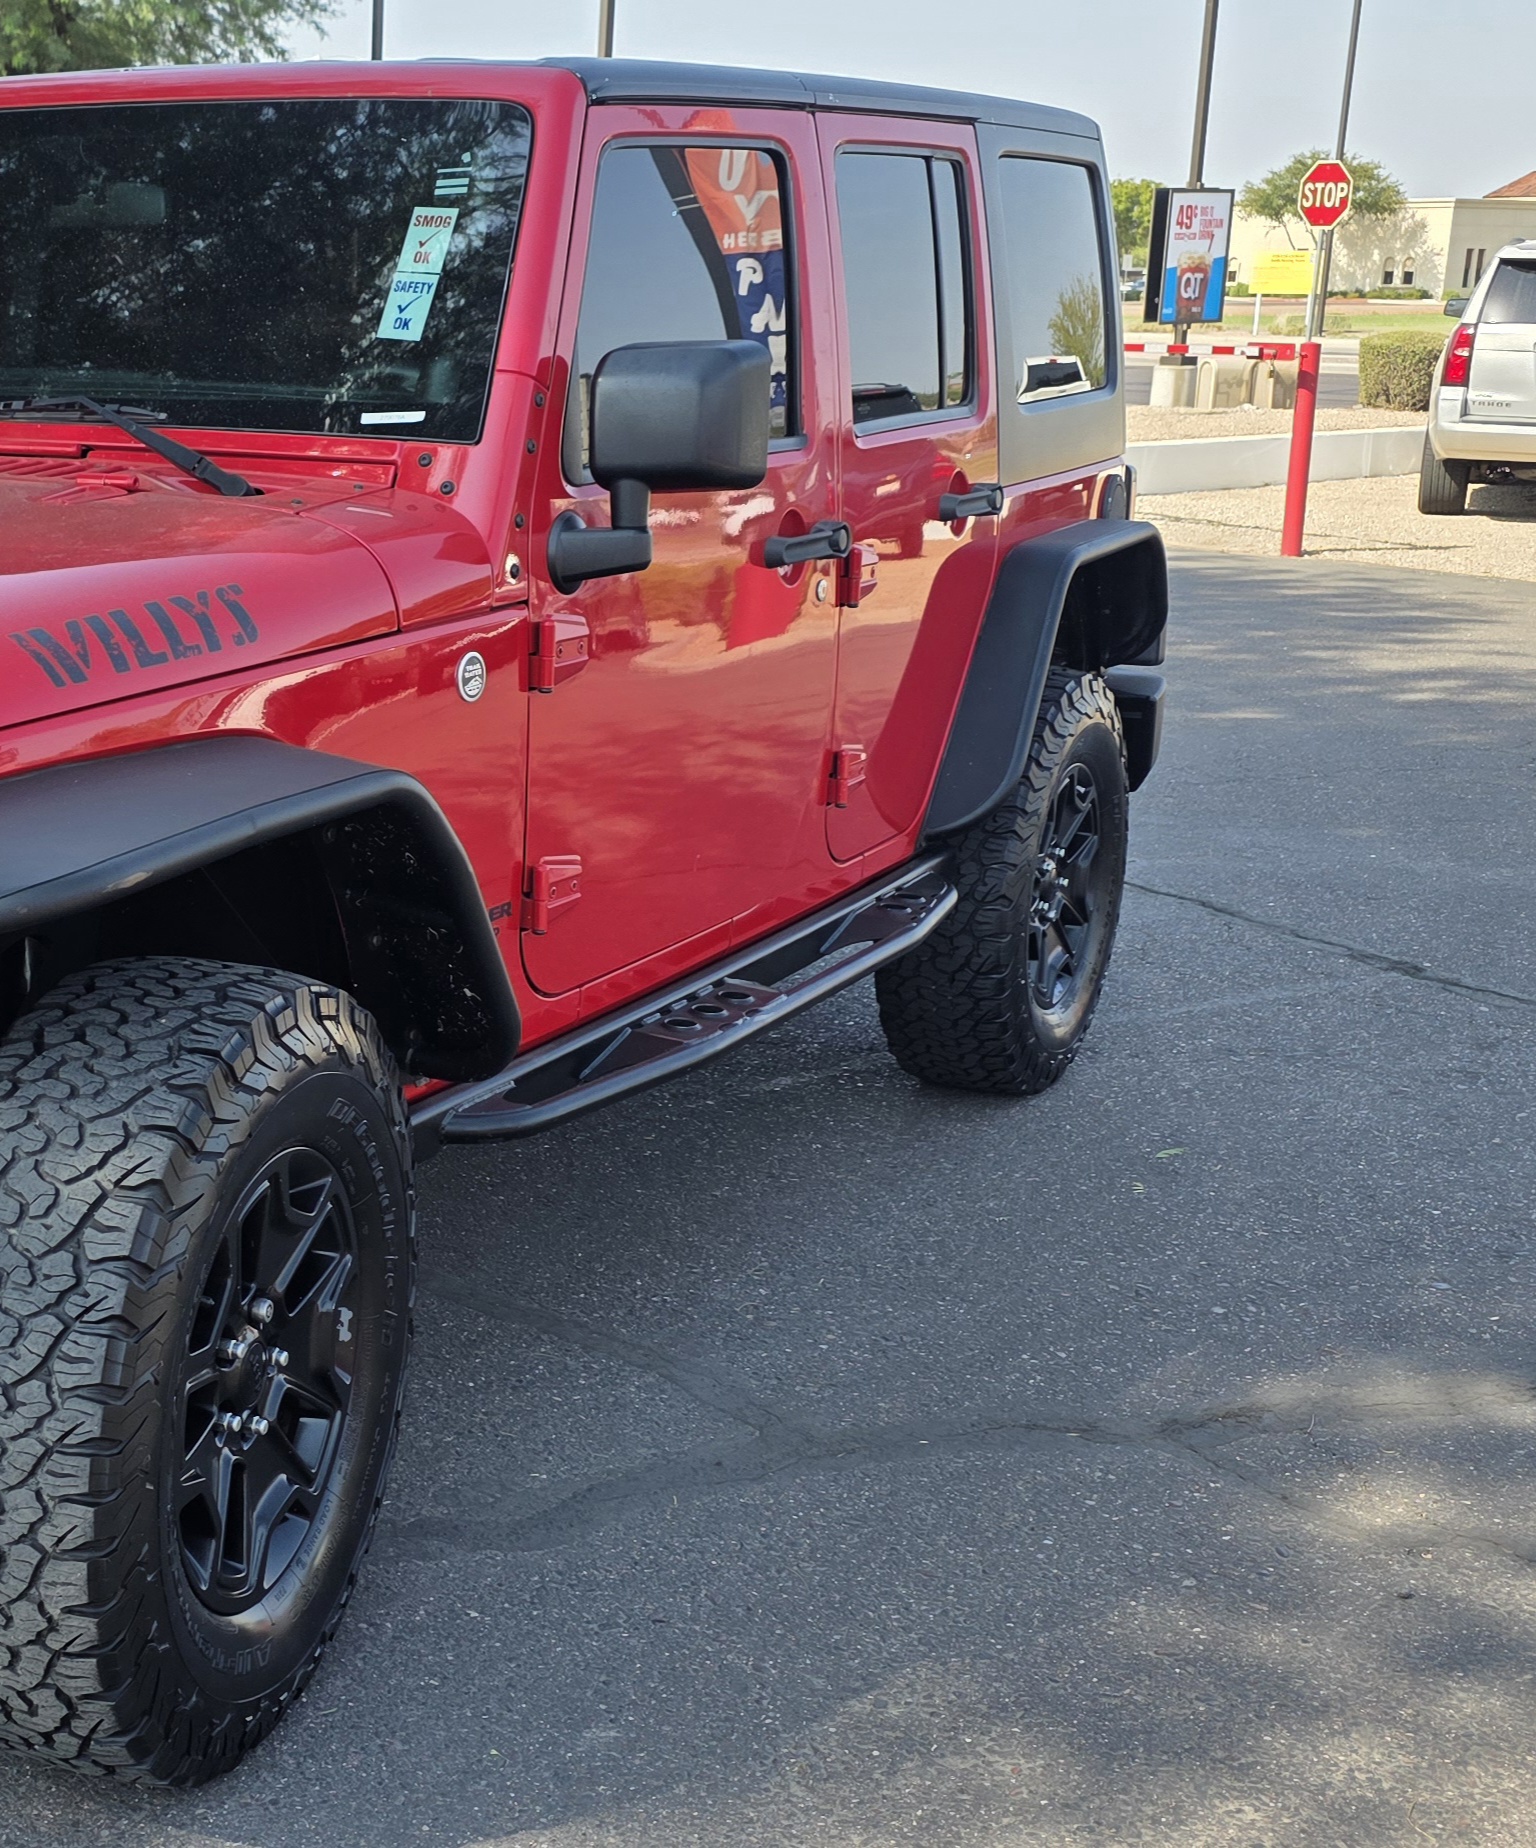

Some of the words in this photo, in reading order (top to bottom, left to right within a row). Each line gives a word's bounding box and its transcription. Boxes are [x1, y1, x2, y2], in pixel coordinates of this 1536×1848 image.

[1301, 181, 1349, 208] STOP
[413, 214, 452, 229] SMOG
[413, 251, 431, 264] OK
[394, 280, 434, 295] SAFETY
[1180, 271, 1204, 301] QT
[393, 317, 413, 331] OK
[1472, 400, 1512, 408] TAHOE
[9, 583, 260, 688] WILLYS
